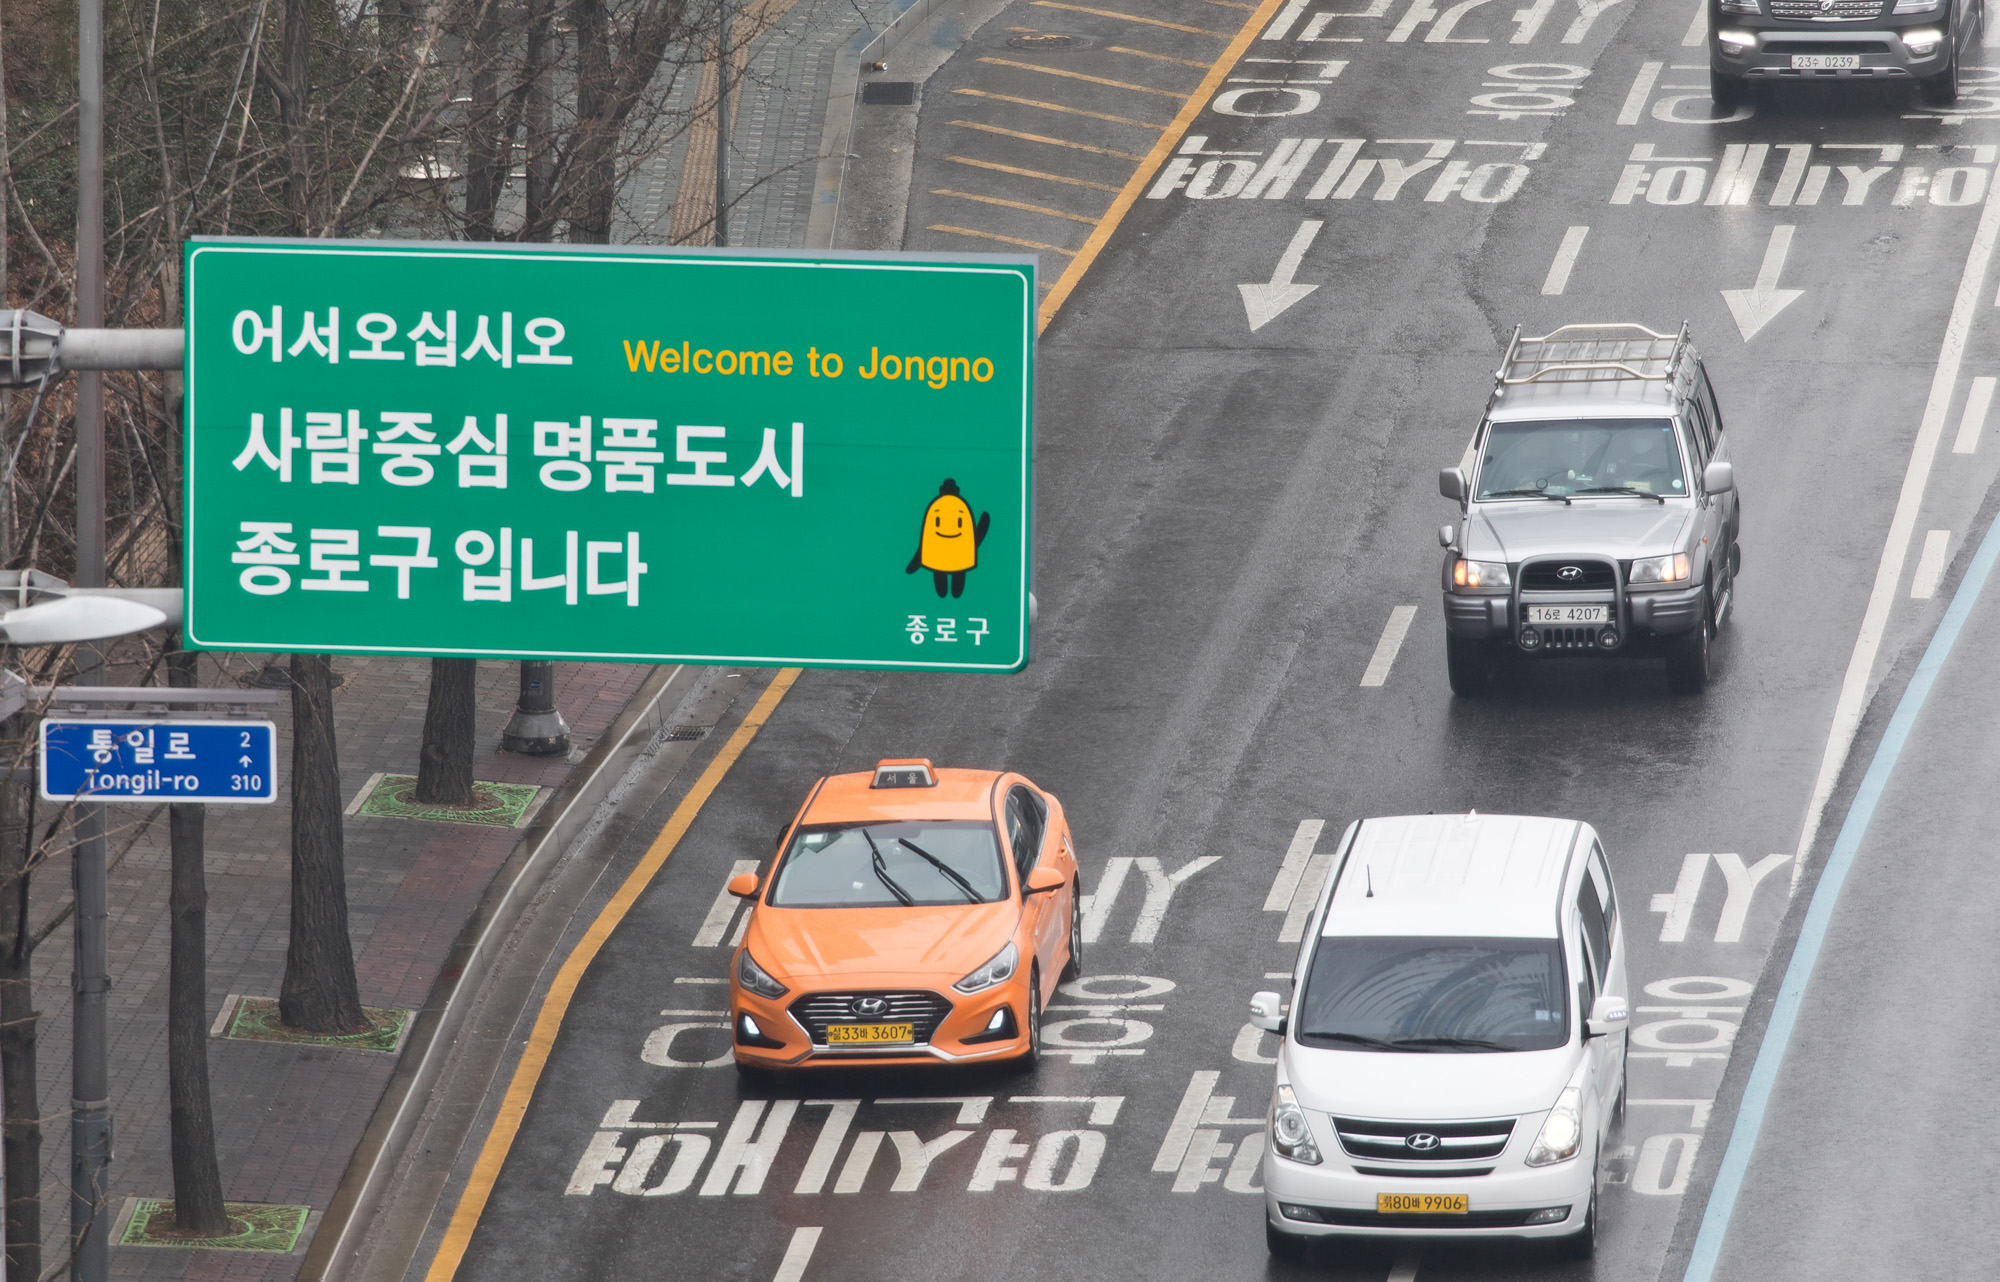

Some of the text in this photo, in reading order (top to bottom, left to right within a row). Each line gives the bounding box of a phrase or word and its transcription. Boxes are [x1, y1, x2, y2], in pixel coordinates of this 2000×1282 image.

[1824, 56, 1853, 68] 0239
[232, 305, 573, 369] 어서오십시오
[622, 339, 995, 390] Welcome to Jongno
[231, 407, 804, 497] 사람중심 명품도시
[231, 521, 648, 606] 종로구 입니다
[1536, 608, 1601, 620] 16로 4207
[905, 614, 990, 646] 종로구
[86, 729, 197, 764] 통일로
[240, 732, 251, 748] 2
[84, 769, 200, 795] Tongil-ro
[231, 774, 262, 791] 310
[872, 1026, 907, 1039] 3607
[1424, 1196, 1462, 1210] 9906
